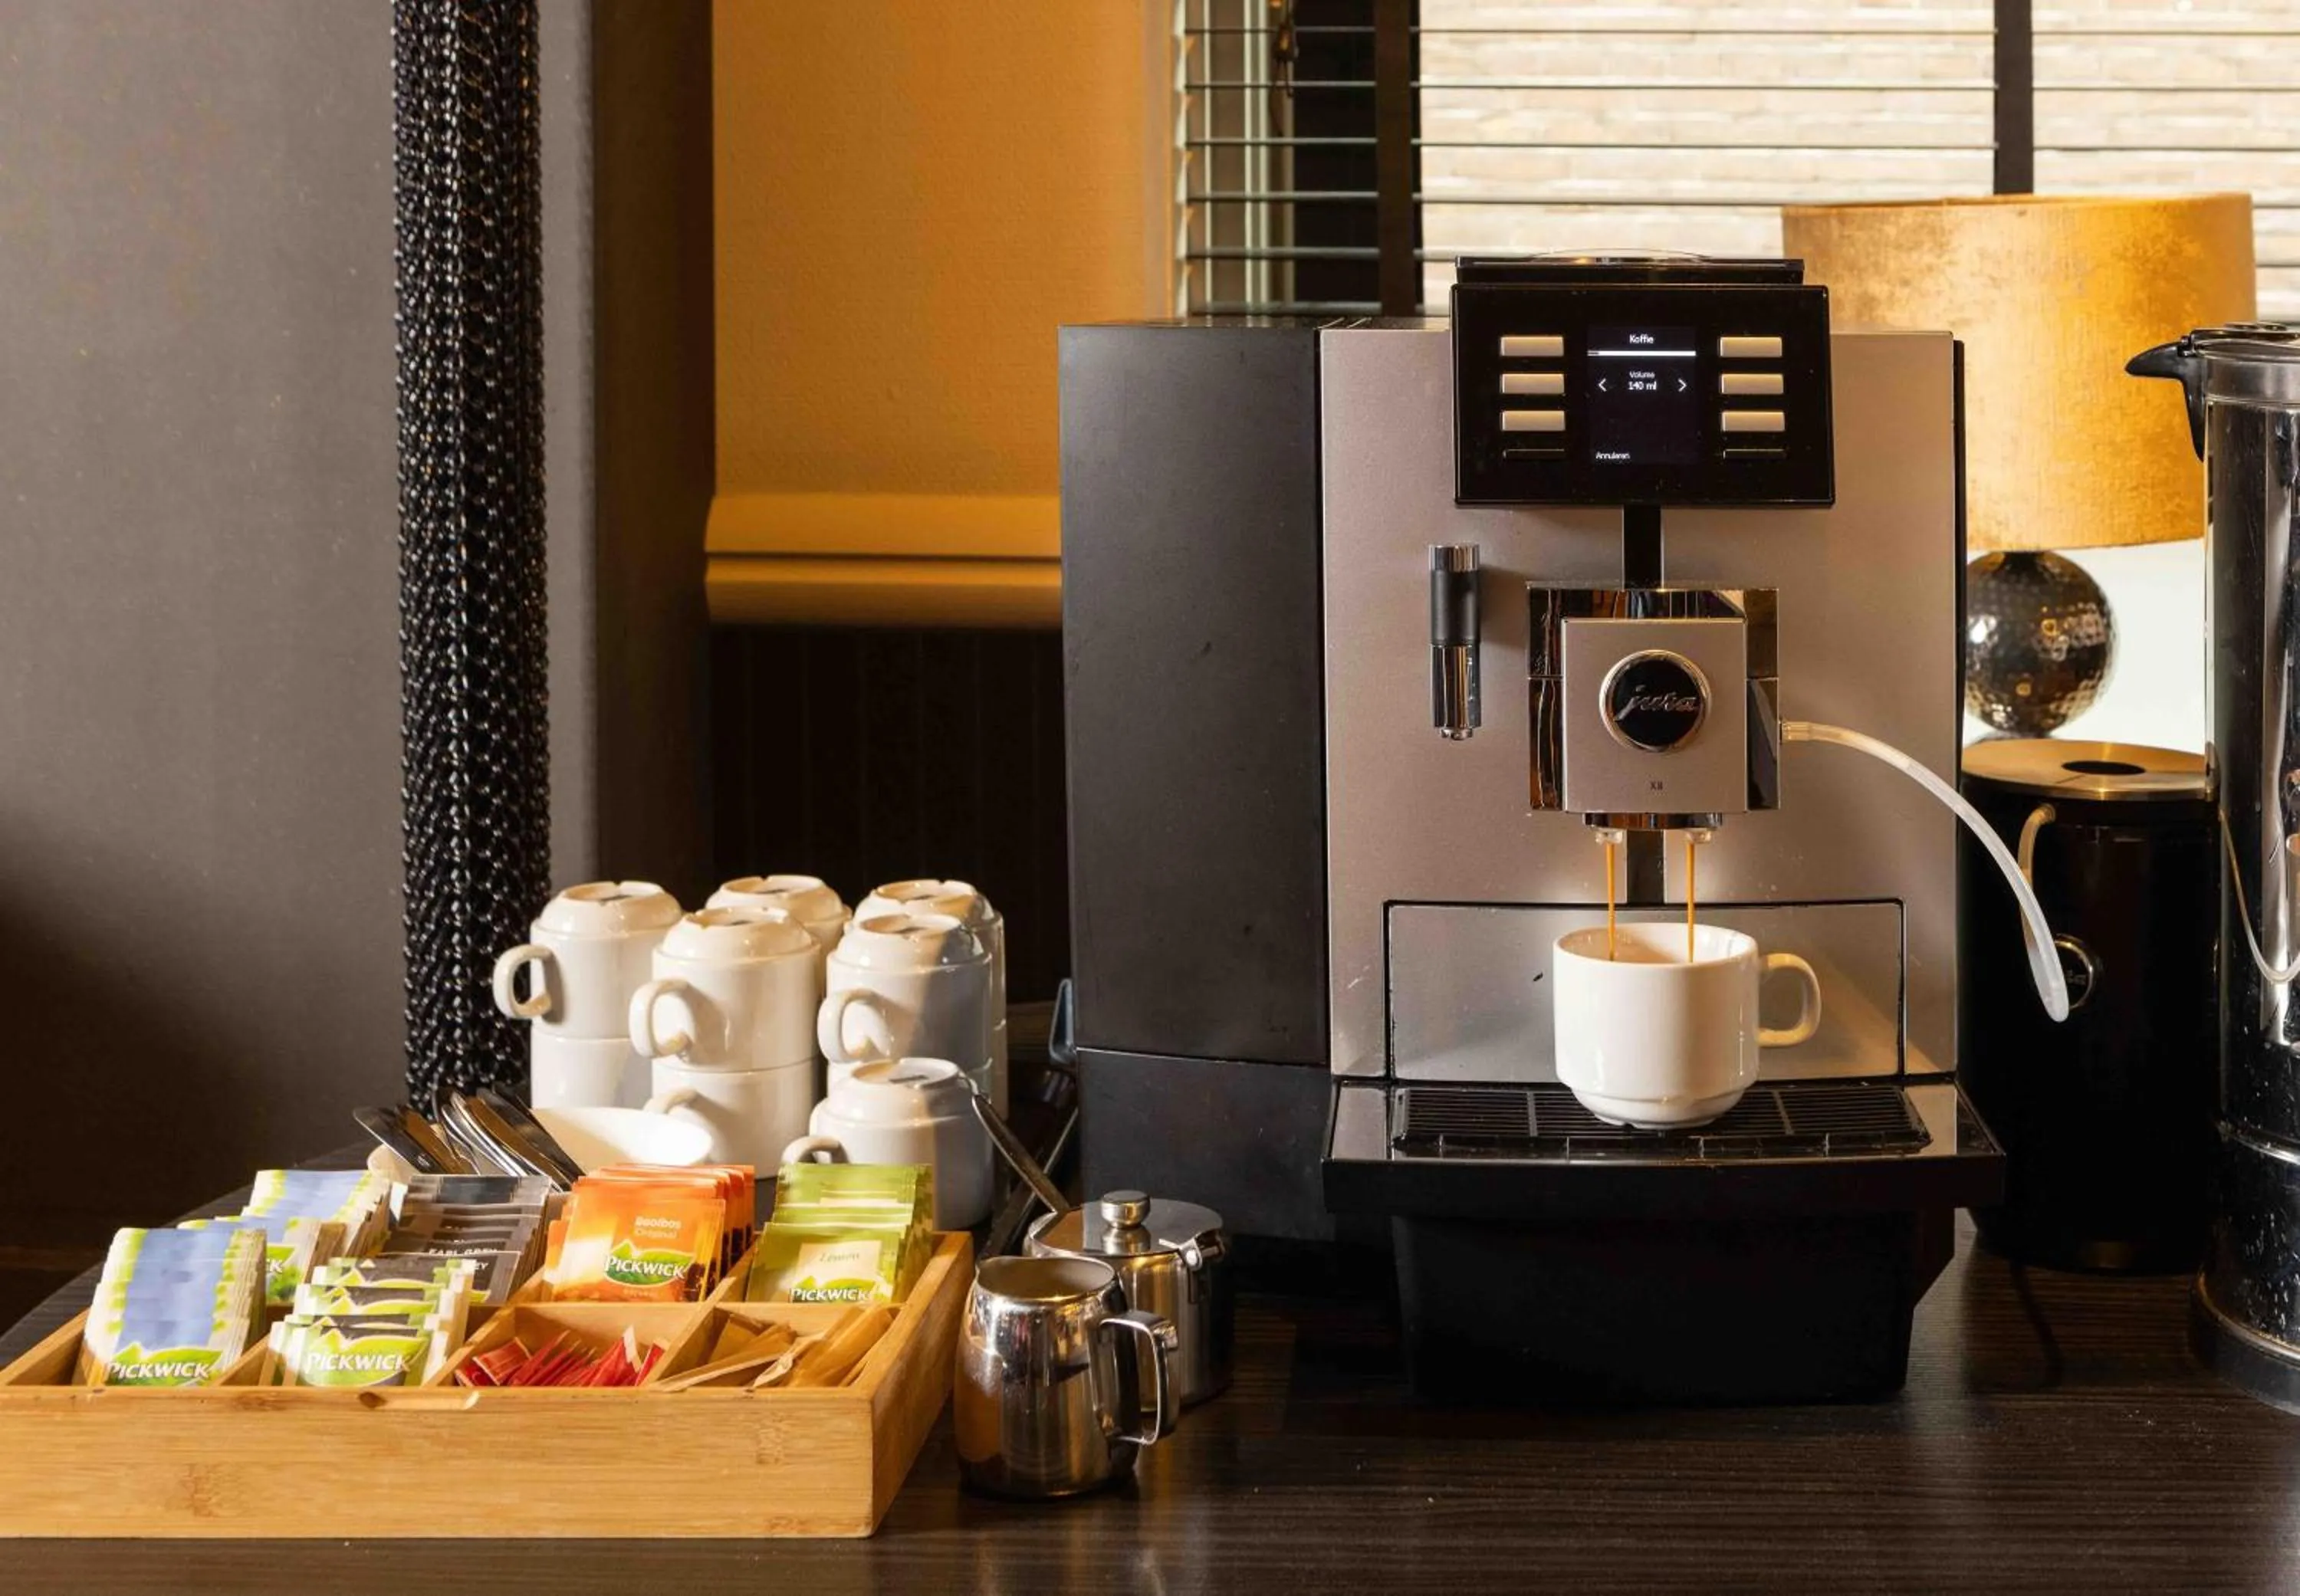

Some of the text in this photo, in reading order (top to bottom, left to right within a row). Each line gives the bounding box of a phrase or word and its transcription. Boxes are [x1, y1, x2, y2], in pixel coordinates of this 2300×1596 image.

[1628, 333, 1654, 344] Koffie
[1628, 380, 1657, 390] 140 ml
[603, 1255, 685, 1279] PICKWICK
[790, 1287, 873, 1302] PICKWICK
[107, 1360, 209, 1379] PICKWICK
[304, 1351, 411, 1374] PICKWICK
